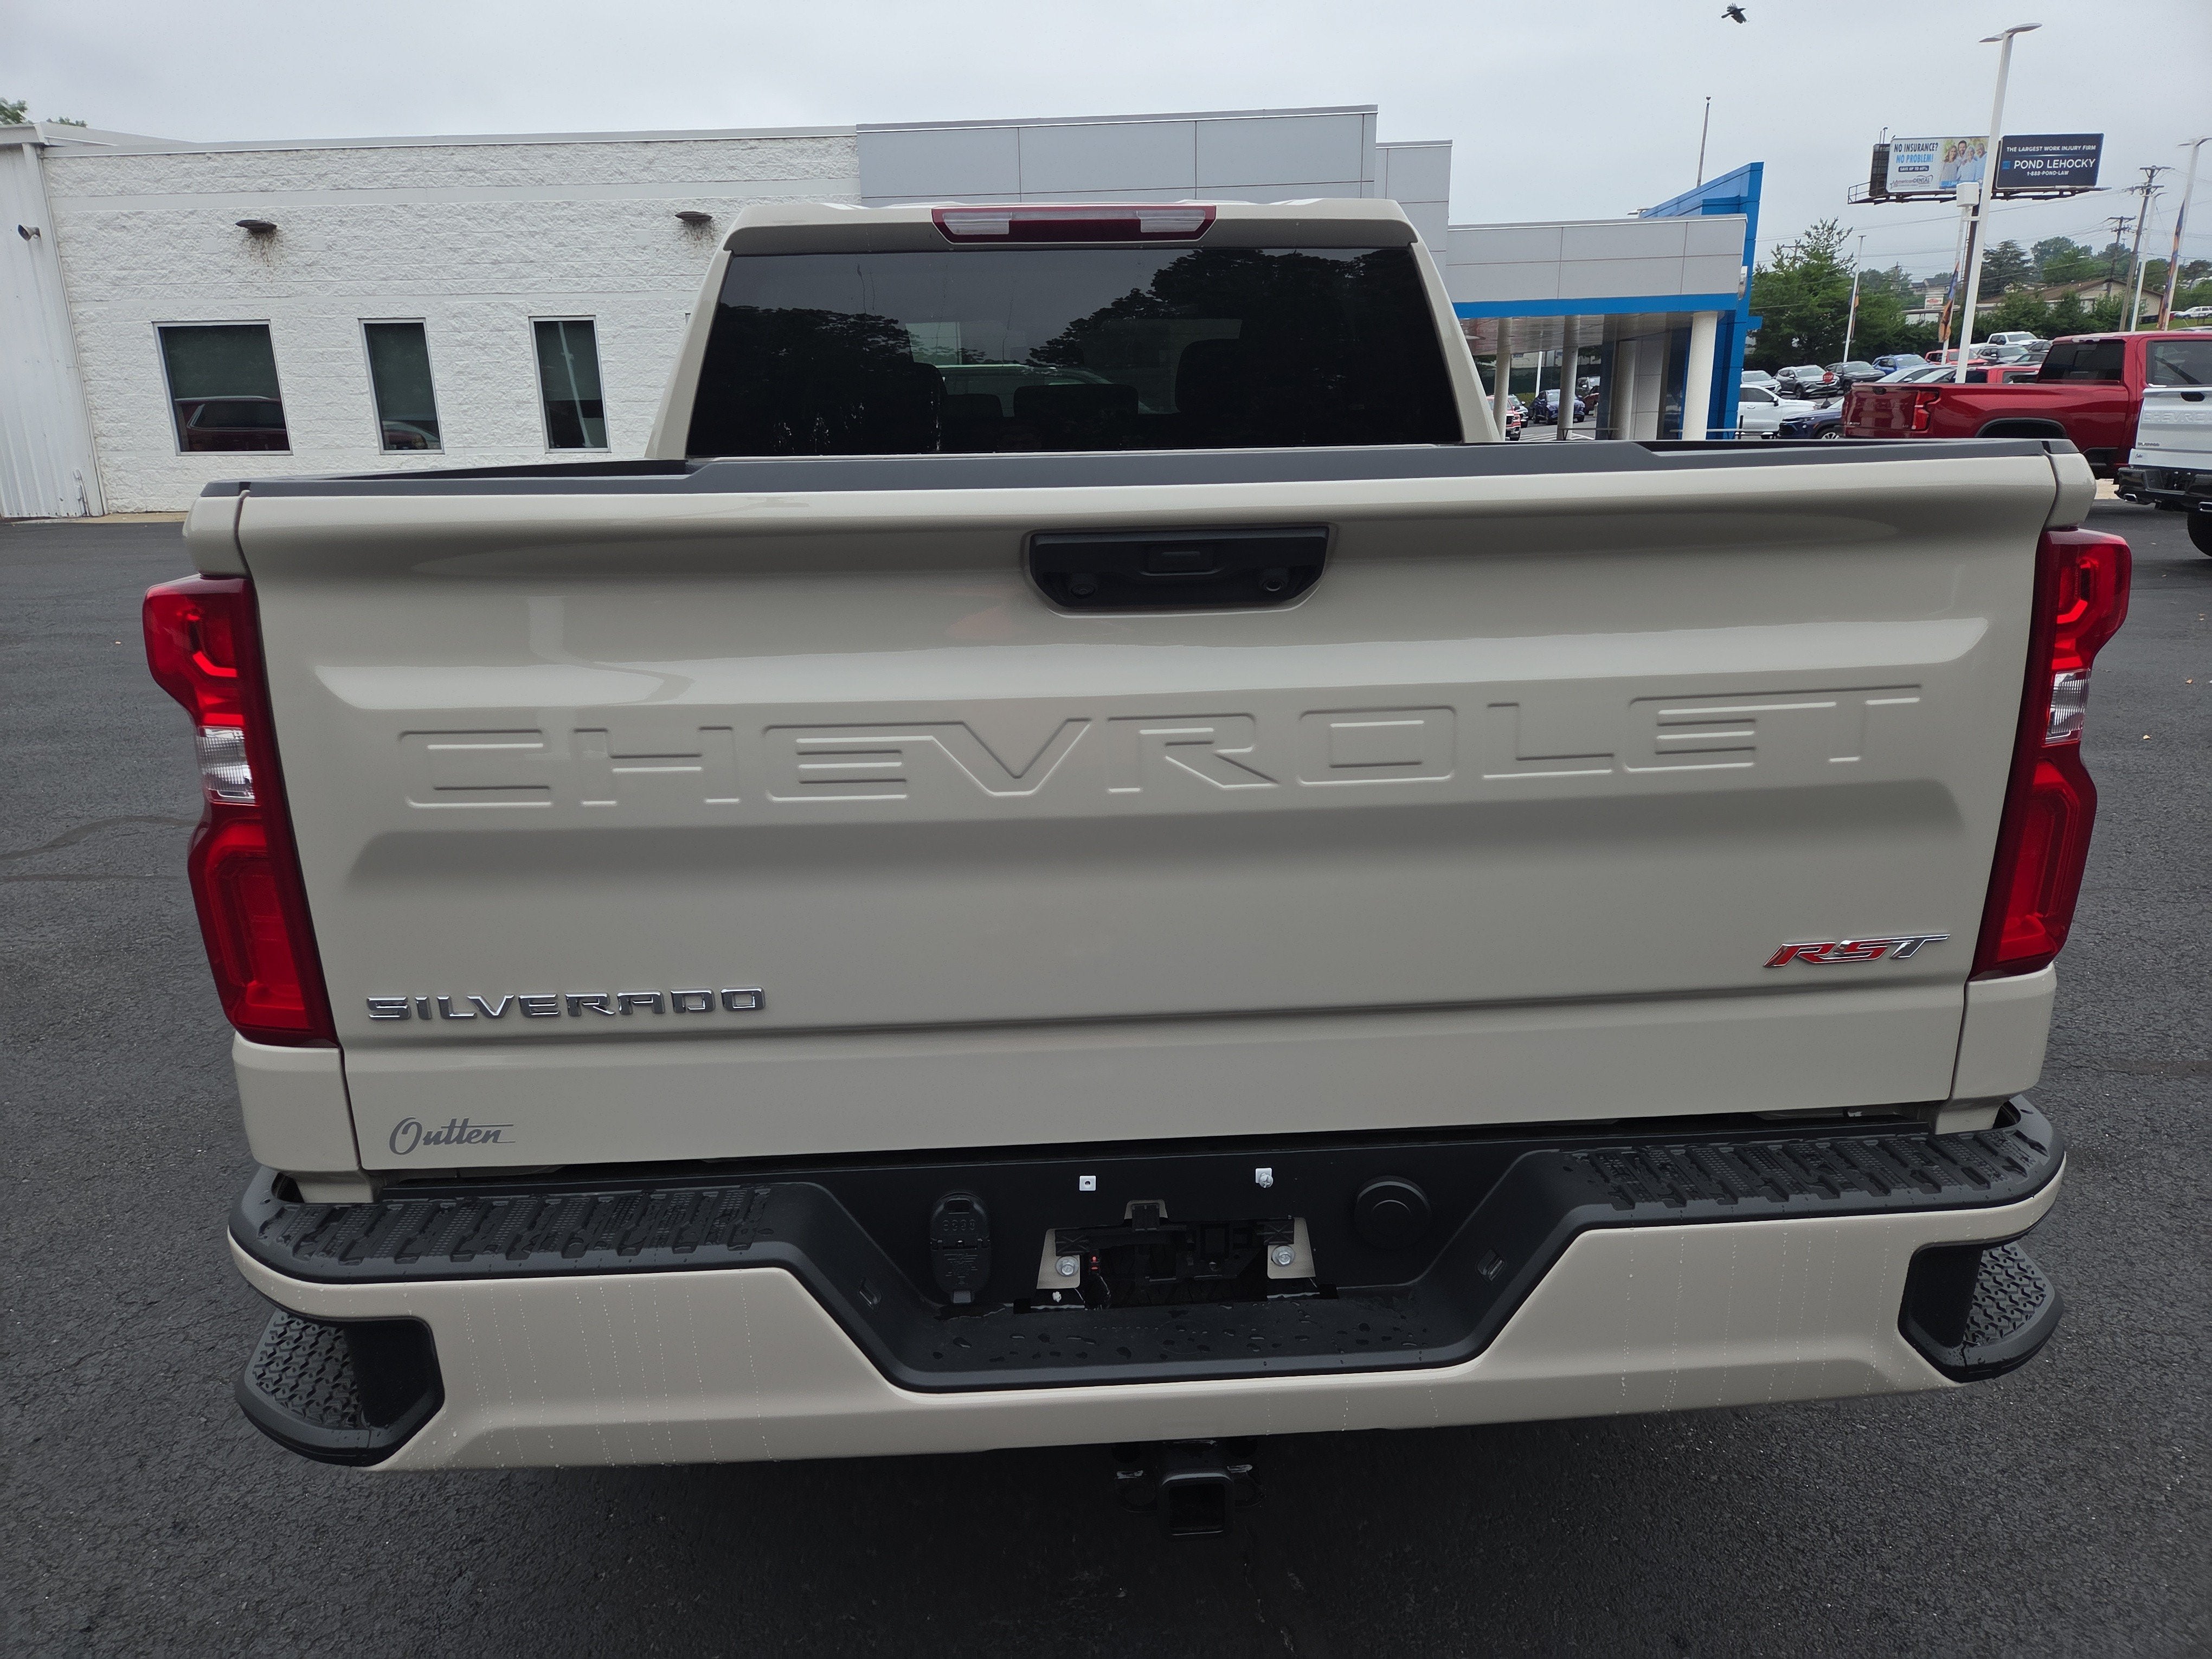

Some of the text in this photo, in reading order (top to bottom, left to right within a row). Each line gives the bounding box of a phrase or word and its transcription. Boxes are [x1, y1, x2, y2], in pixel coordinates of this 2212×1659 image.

[1894, 142, 1939, 152] NO INSURANCE?
[1896, 153, 1934, 163] NO PROBLEM!
[2014, 159, 2044, 169] POND
[2047, 158, 2096, 169] LEHOCKY
[398, 684, 1923, 808] CHEVROLET
[1763, 934, 1951, 968] RST
[366, 986, 766, 1021] SILVERADO
[389, 1117, 516, 1155] Outten
